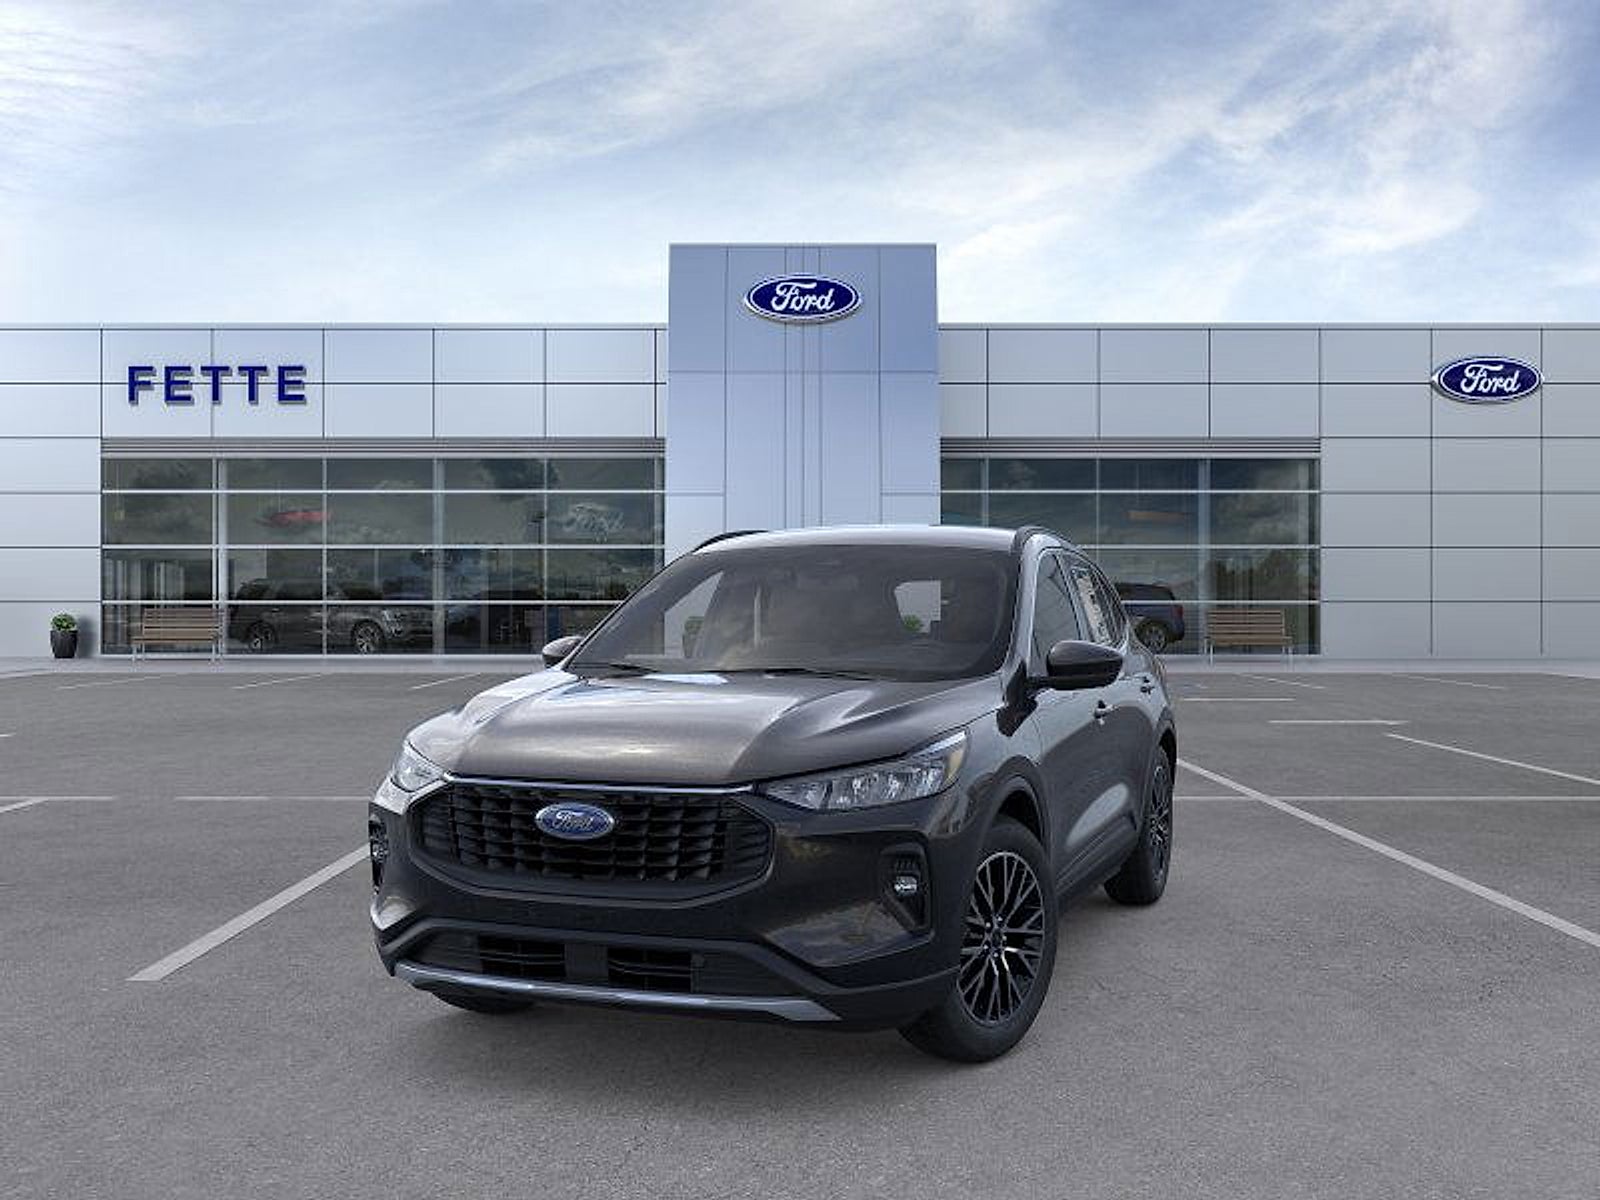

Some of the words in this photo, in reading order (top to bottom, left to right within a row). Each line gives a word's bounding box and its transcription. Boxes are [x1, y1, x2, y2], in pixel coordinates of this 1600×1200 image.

[771, 281, 835, 312] Ford
[127, 365, 307, 405] FETTE
[1460, 363, 1521, 393] Ford
[551, 810, 596, 830] Ford
